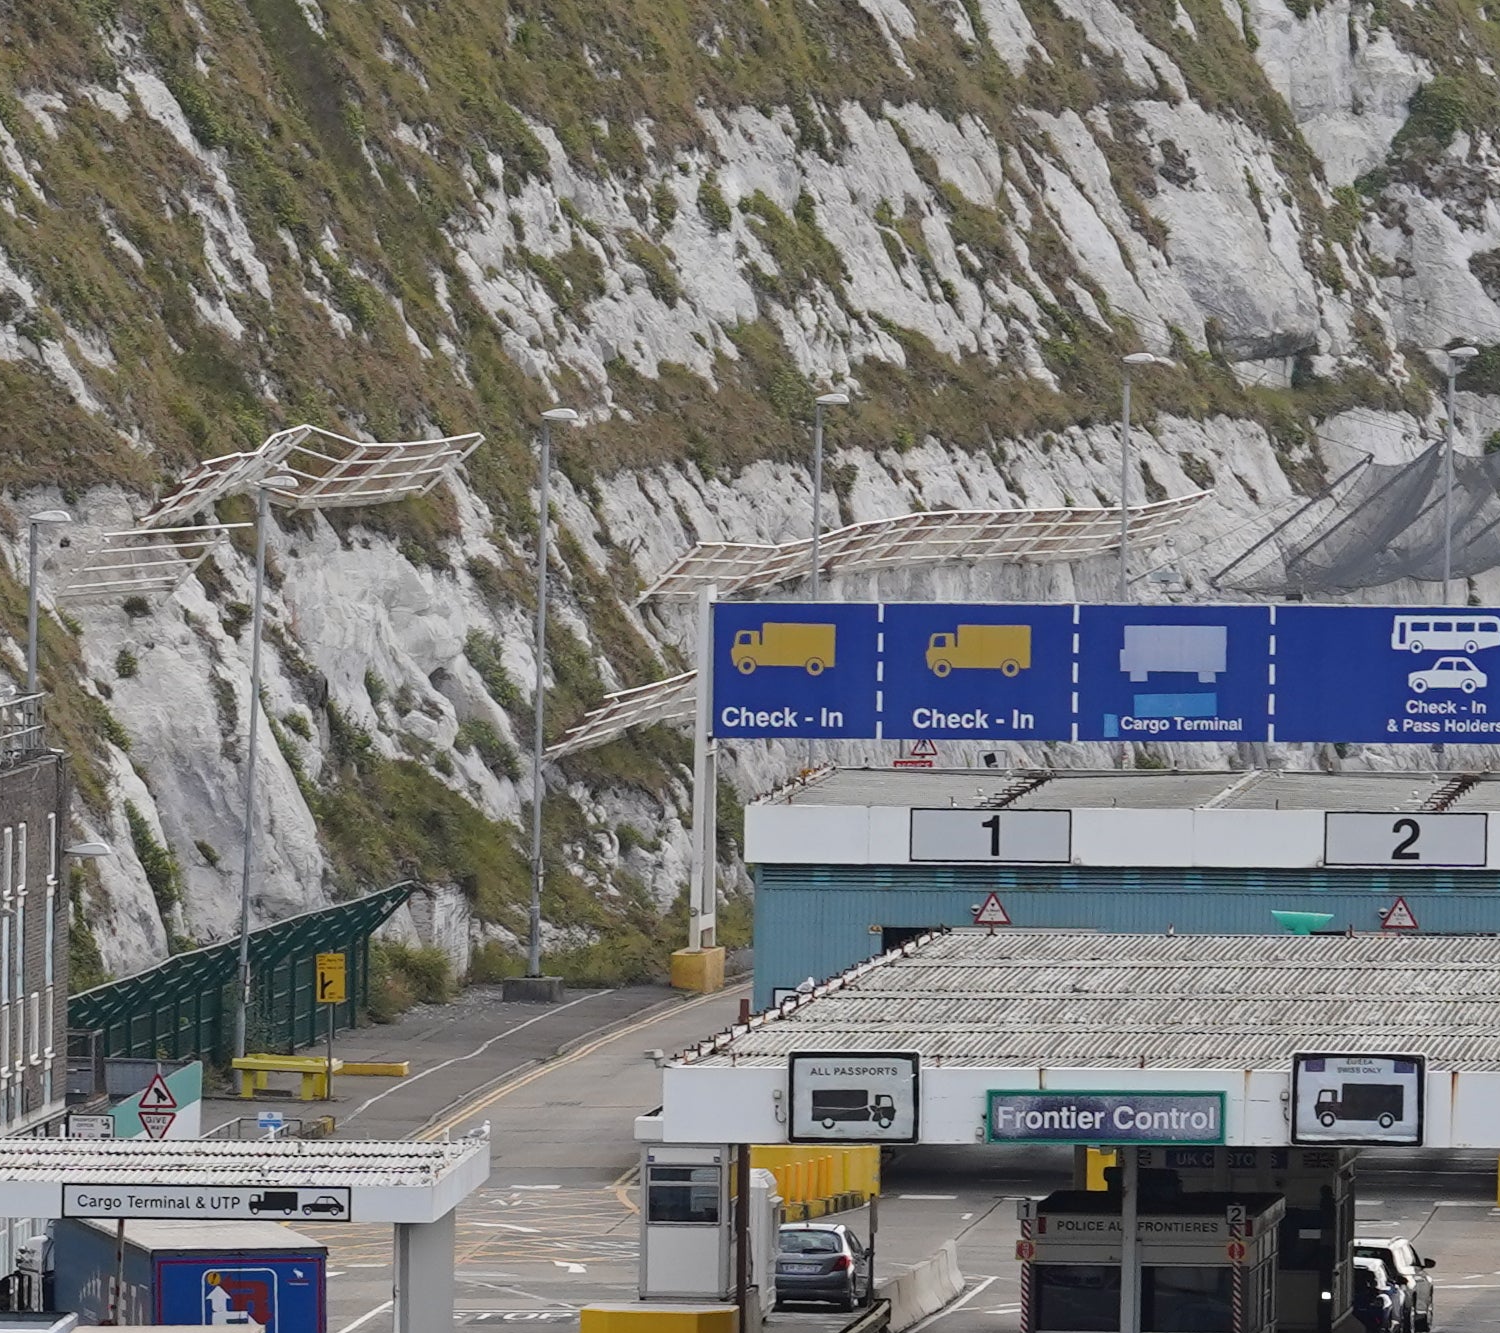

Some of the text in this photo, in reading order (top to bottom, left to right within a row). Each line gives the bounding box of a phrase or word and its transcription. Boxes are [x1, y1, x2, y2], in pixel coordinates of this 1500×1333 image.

[1405, 699, 1457, 714] Check
[1471, 700, 1487, 714] In
[720, 706, 798, 727] Check
[822, 706, 844, 727] In
[912, 708, 989, 728] Check
[1012, 709, 1035, 728] In
[1120, 716, 1243, 734] Cargo Terminal
[1402, 718, 1434, 733] Pass
[982, 815, 1000, 856] 1
[1391, 818, 1420, 860] 2
[810, 1066, 898, 1077] ALL PASSPORTS
[145, 1116, 167, 1125] GIVE
[998, 1106, 1217, 1131] Frontier Control
[77, 1194, 241, 1213] Cargo Terminal & UTP
[1023, 1203, 1031, 1217] 1
[1231, 1206, 1243, 1223] 2
[1056, 1220, 1104, 1233] POLICE
[1138, 1221, 1219, 1234] FRONTIERES
